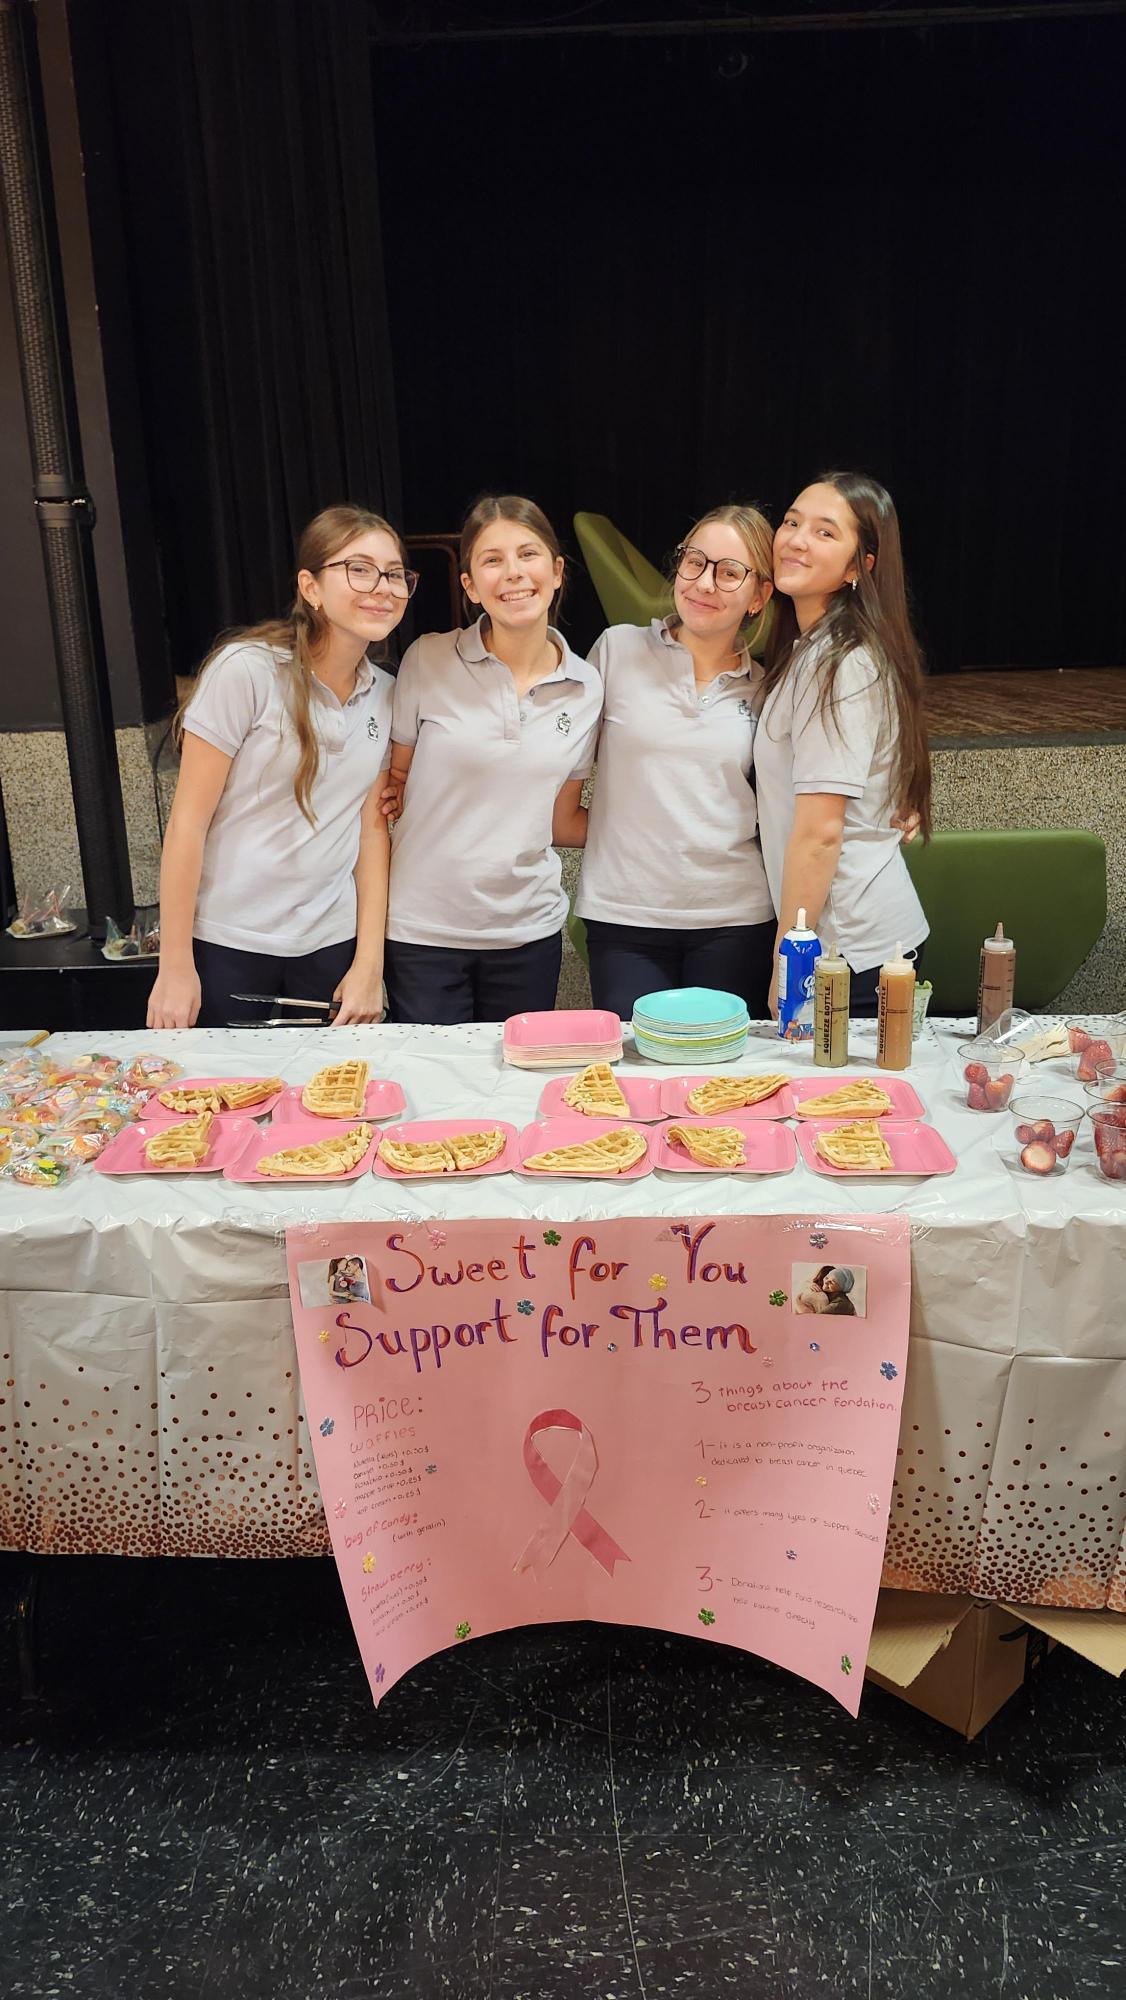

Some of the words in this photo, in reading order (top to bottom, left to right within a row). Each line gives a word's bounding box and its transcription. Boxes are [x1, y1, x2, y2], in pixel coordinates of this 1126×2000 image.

[385, 1233, 536, 1292] Sweet
[569, 1235, 629, 1300] for
[670, 1221, 748, 1284] You
[334, 1298, 518, 1373] Support
[541, 1304, 600, 1357] for
[609, 1297, 757, 1355] Them
[691, 1380, 711, 1404] 3
[718, 1383, 764, 1398] things
[772, 1380, 812, 1391] about
[821, 1379, 849, 1391] the
[726, 1396, 772, 1412] breast
[775, 1396, 827, 1408] cancer
[732, 1440, 741, 1448] is
[756, 1440, 804, 1450] non-profit
[807, 1442, 855, 1456] organization
[769, 1457, 793, 1465] breast
[796, 1459, 821, 1467] cancer
[763, 1511, 783, 1521] many
[344, 1532, 364, 1548] bag
[365, 1520, 379, 1537] of
